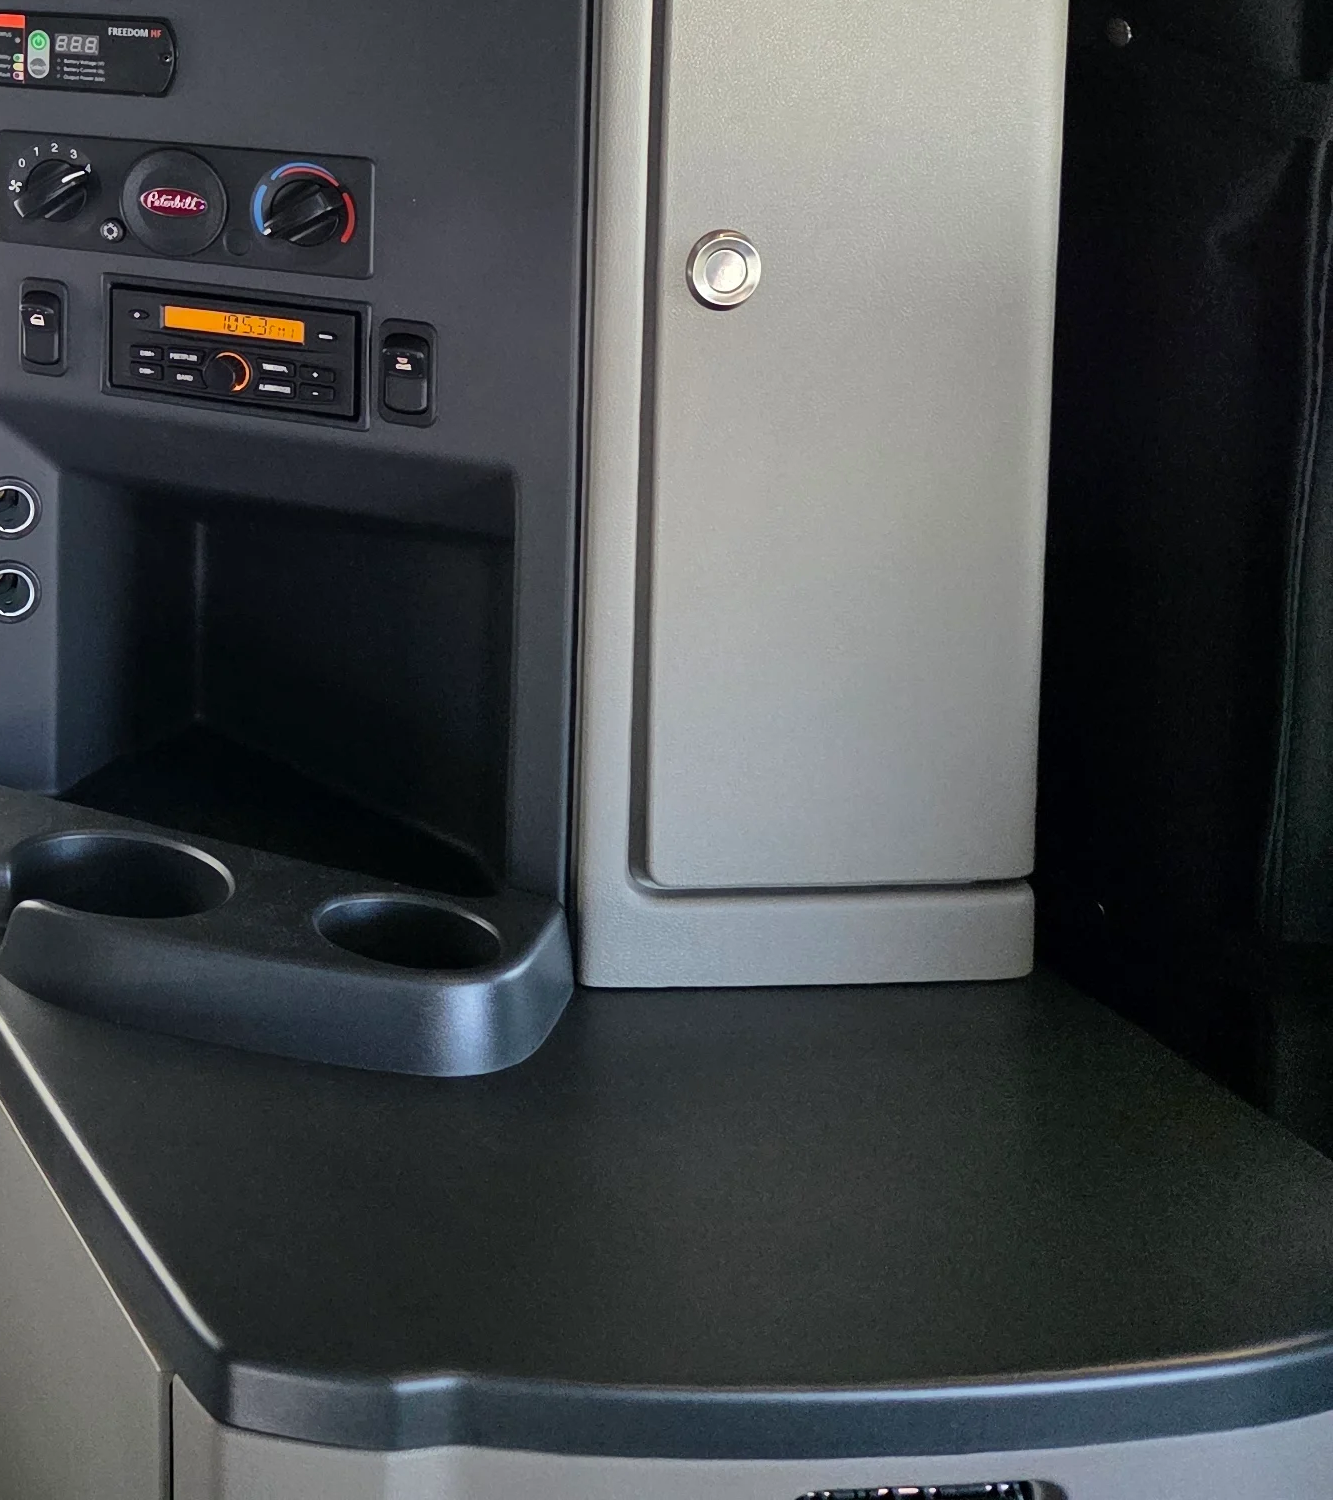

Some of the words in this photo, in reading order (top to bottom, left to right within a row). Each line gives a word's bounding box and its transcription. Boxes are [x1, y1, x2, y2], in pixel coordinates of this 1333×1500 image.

[108, 26, 149, 38] FREEDOM
[150, 29, 162, 38] HF
[33, 146, 40, 157] 1
[51, 142, 59, 153] 2
[70, 148, 78, 159] 3
[18, 158, 26, 168] 0
[84, 163, 92, 174] 4
[146, 191, 205, 211] Peterbilt
[223, 314, 268, 336] 105.3
